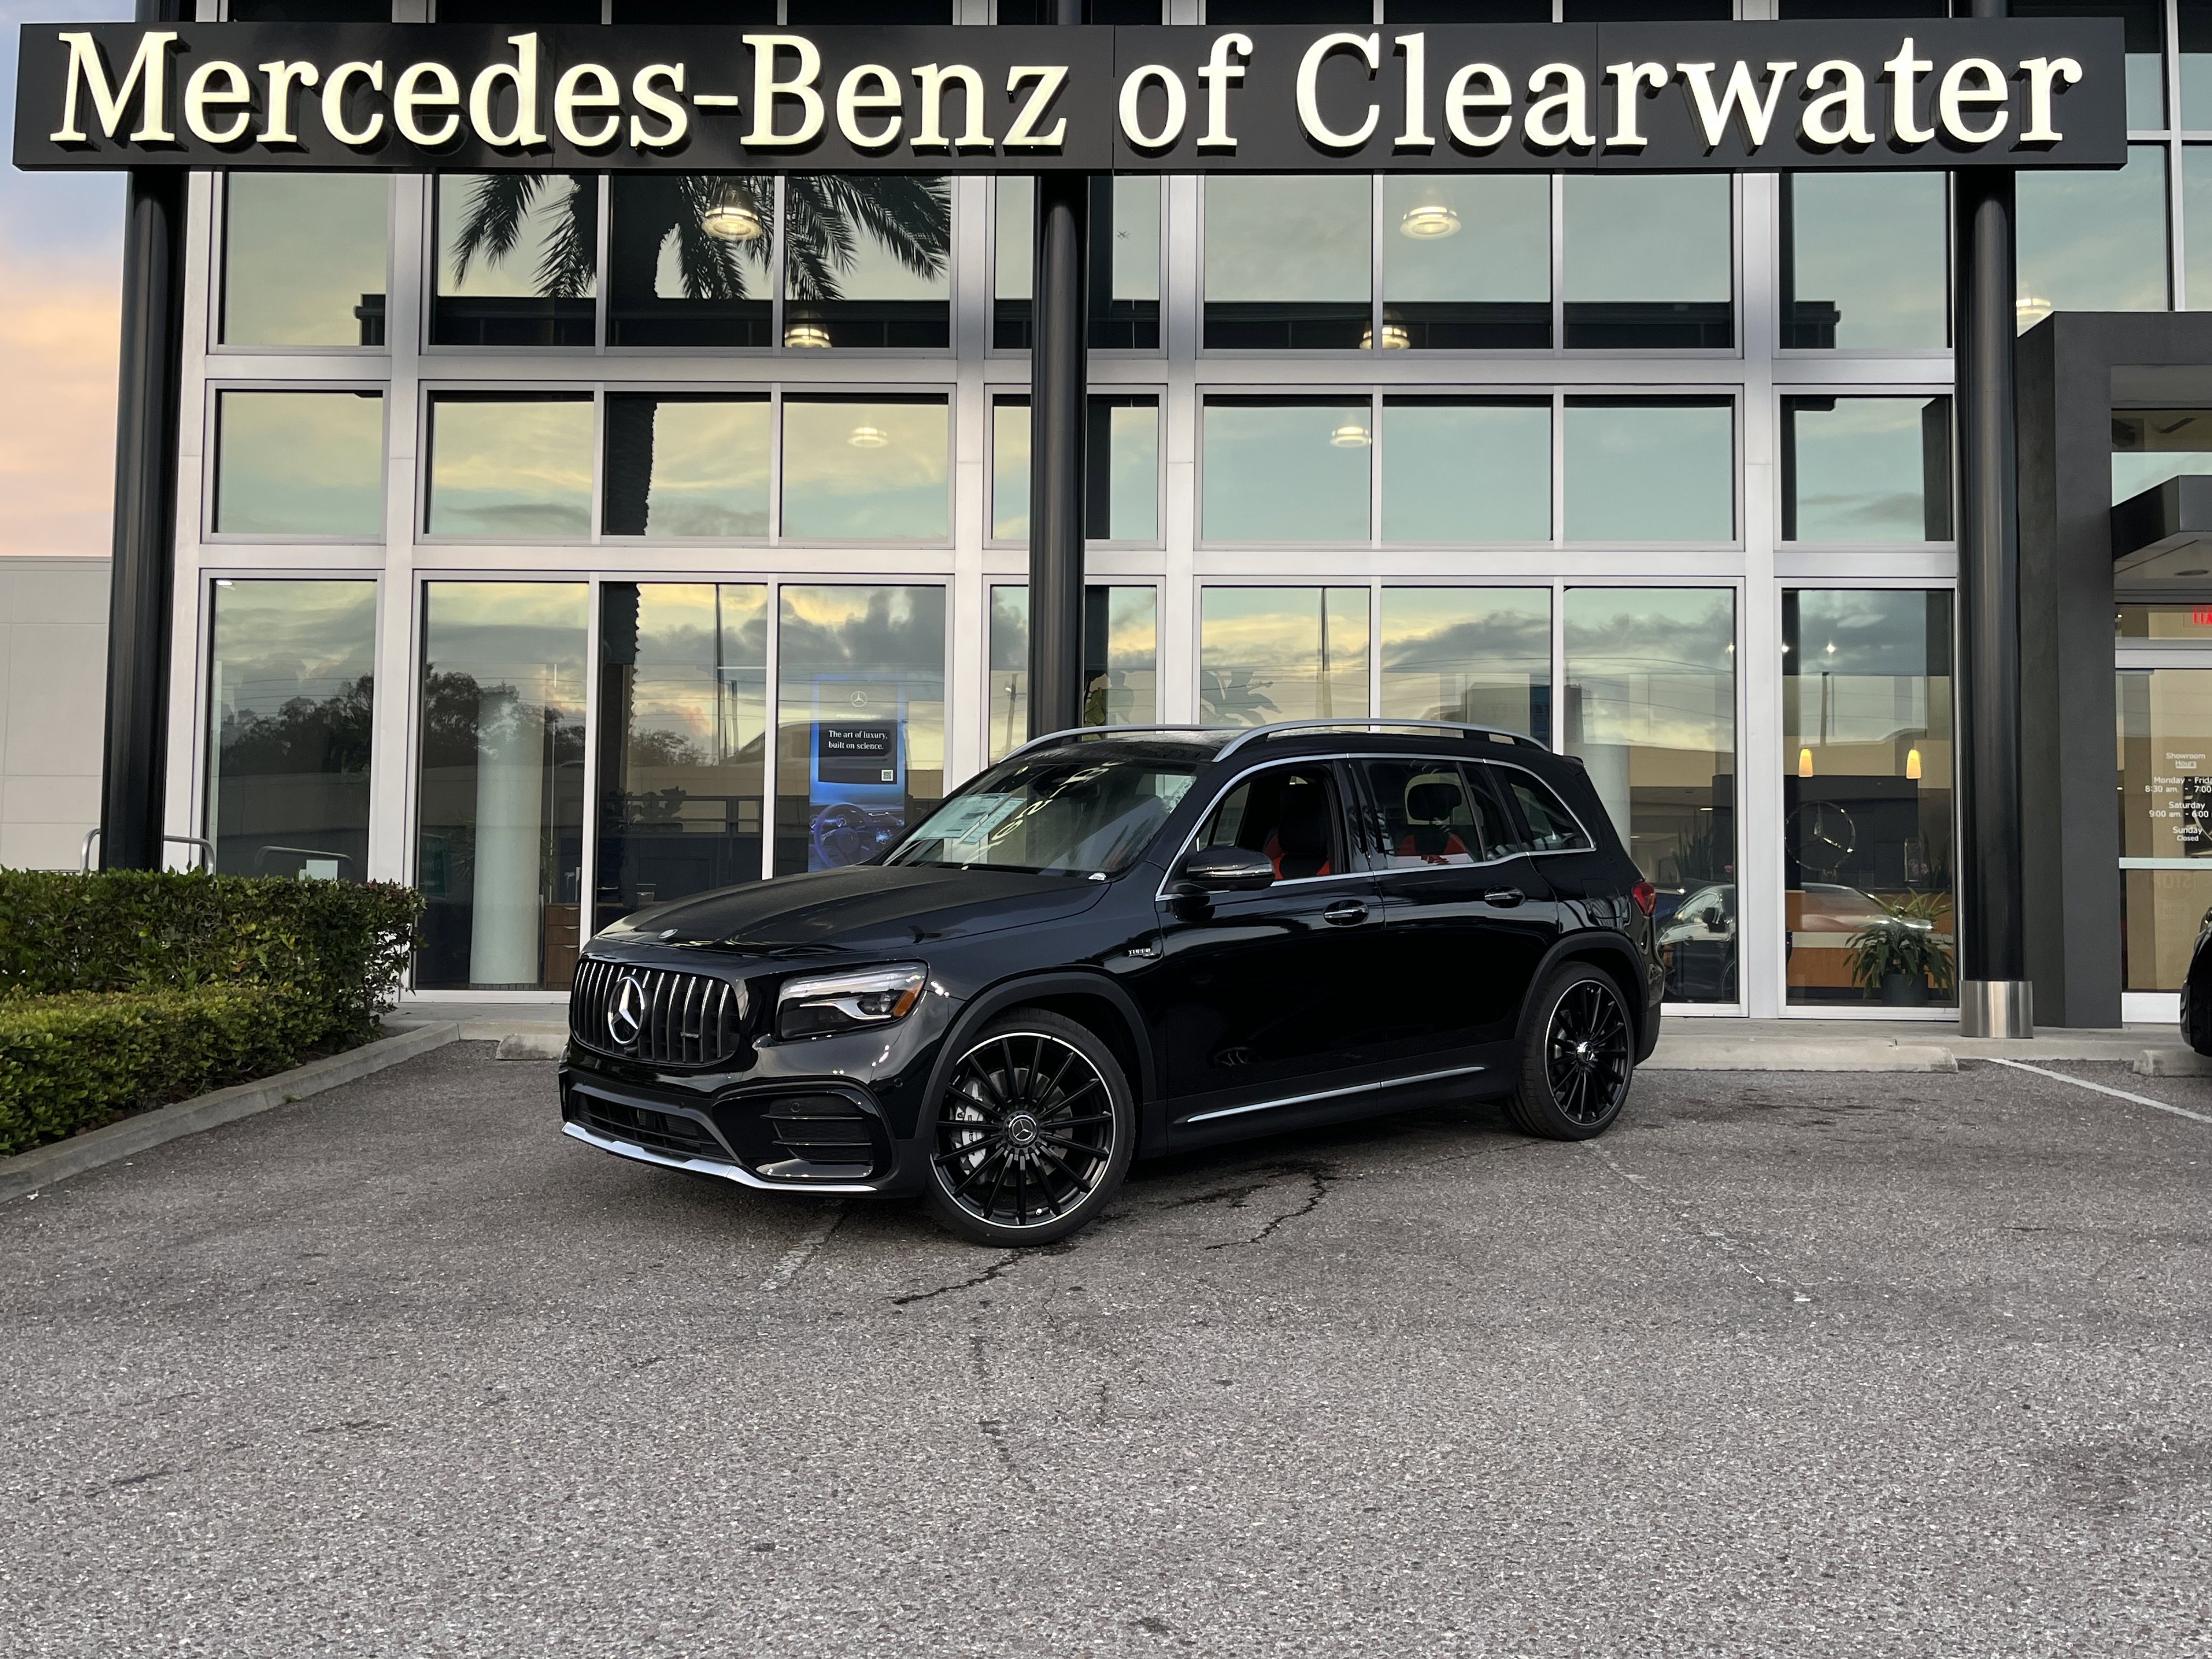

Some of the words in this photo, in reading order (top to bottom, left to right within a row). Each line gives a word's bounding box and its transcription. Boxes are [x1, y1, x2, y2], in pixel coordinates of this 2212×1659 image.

[50, 32, 1069, 146] Mercedes-Benz
[1119, 33, 1253, 146] of
[1296, 32, 2083, 146] Clearwater
[864, 731, 888, 740] luxury,
[2169, 802, 2205, 810] Saturday
[2172, 826, 2202, 834] Sunday
